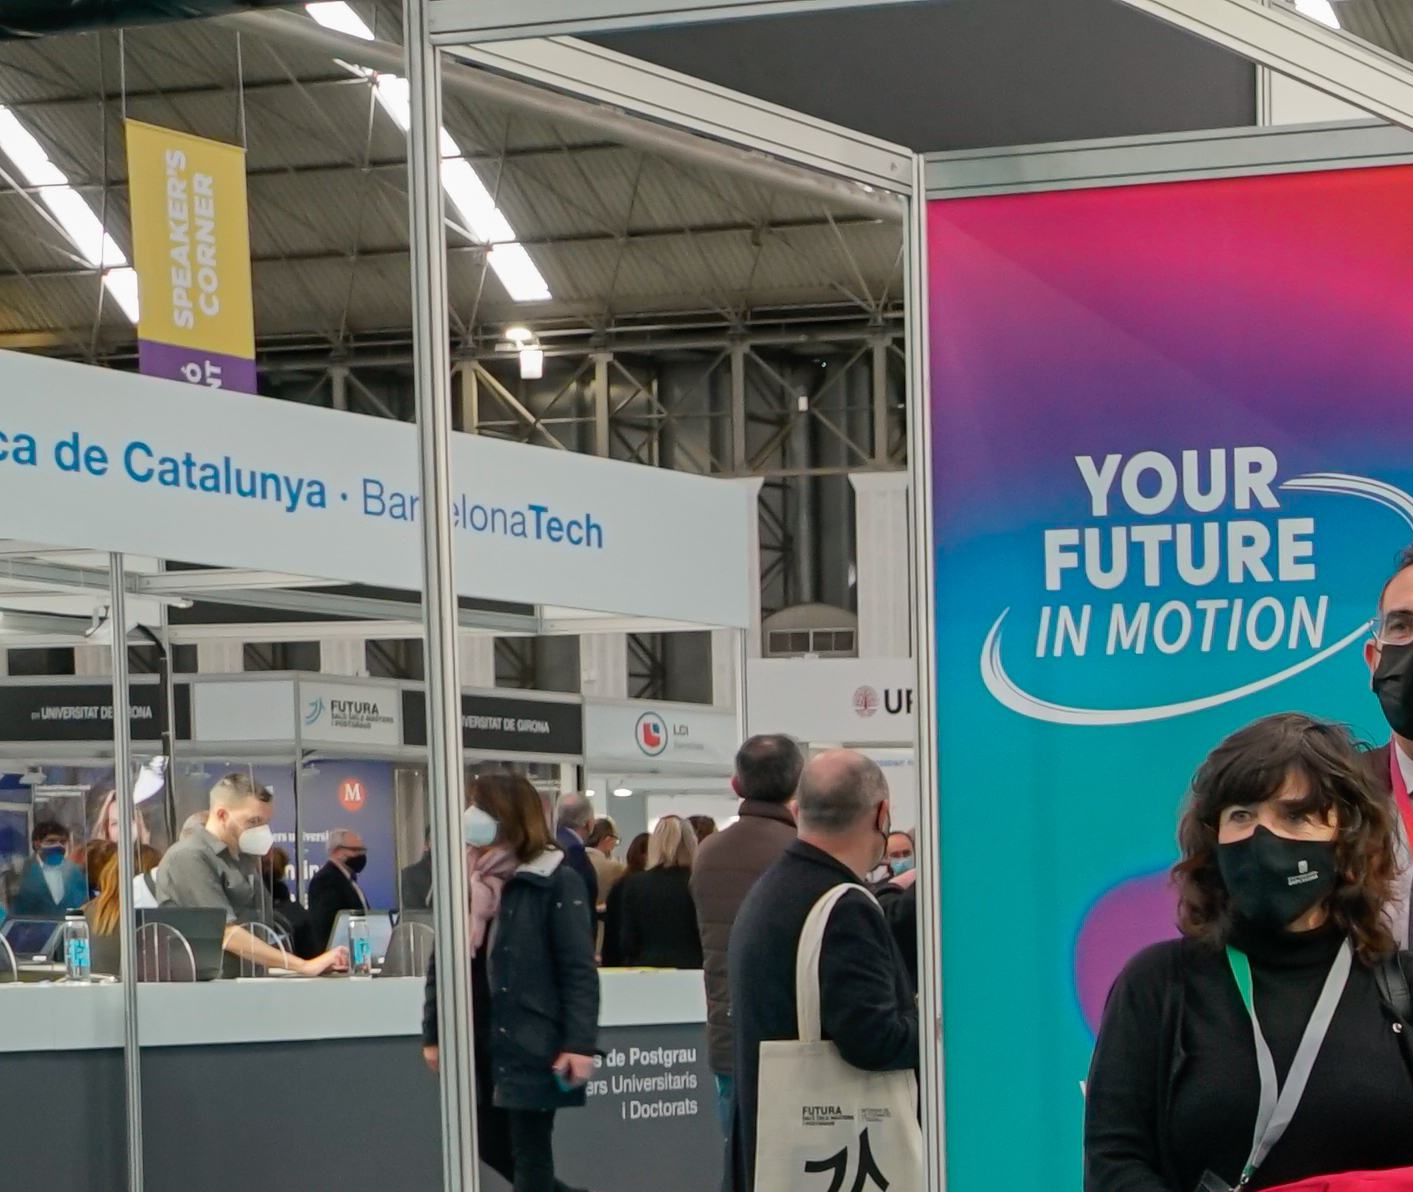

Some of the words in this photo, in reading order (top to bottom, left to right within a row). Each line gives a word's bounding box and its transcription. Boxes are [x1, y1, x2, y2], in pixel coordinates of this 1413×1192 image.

[166, 149, 194, 329] SPEAKER'S
[193, 172, 220, 316] CORNER
[54, 431, 109, 476] de
[124, 440, 327, 513] Catalunya
[1075, 446, 1280, 517] YOUR
[1044, 518, 1316, 591] FUTURE
[1035, 604, 1093, 658] IN
[1105, 595, 1328, 656] MOTION
[41, 706, 100, 720] UNIVERSITAT
[100, 706, 114, 720] DE
[330, 699, 380, 715] FUTURA
[503, 718, 516, 732] DE
[516, 719, 550, 734] GIRONA
[344, 782, 362, 801] M
[606, 1048, 626, 1067] de
[629, 1047, 697, 1068] Postgrau
[611, 1071, 698, 1094] Universitaris
[621, 1101, 626, 1119] i
[630, 1098, 698, 1120] Doctorats
[802, 1105, 842, 1115] FUTURA
